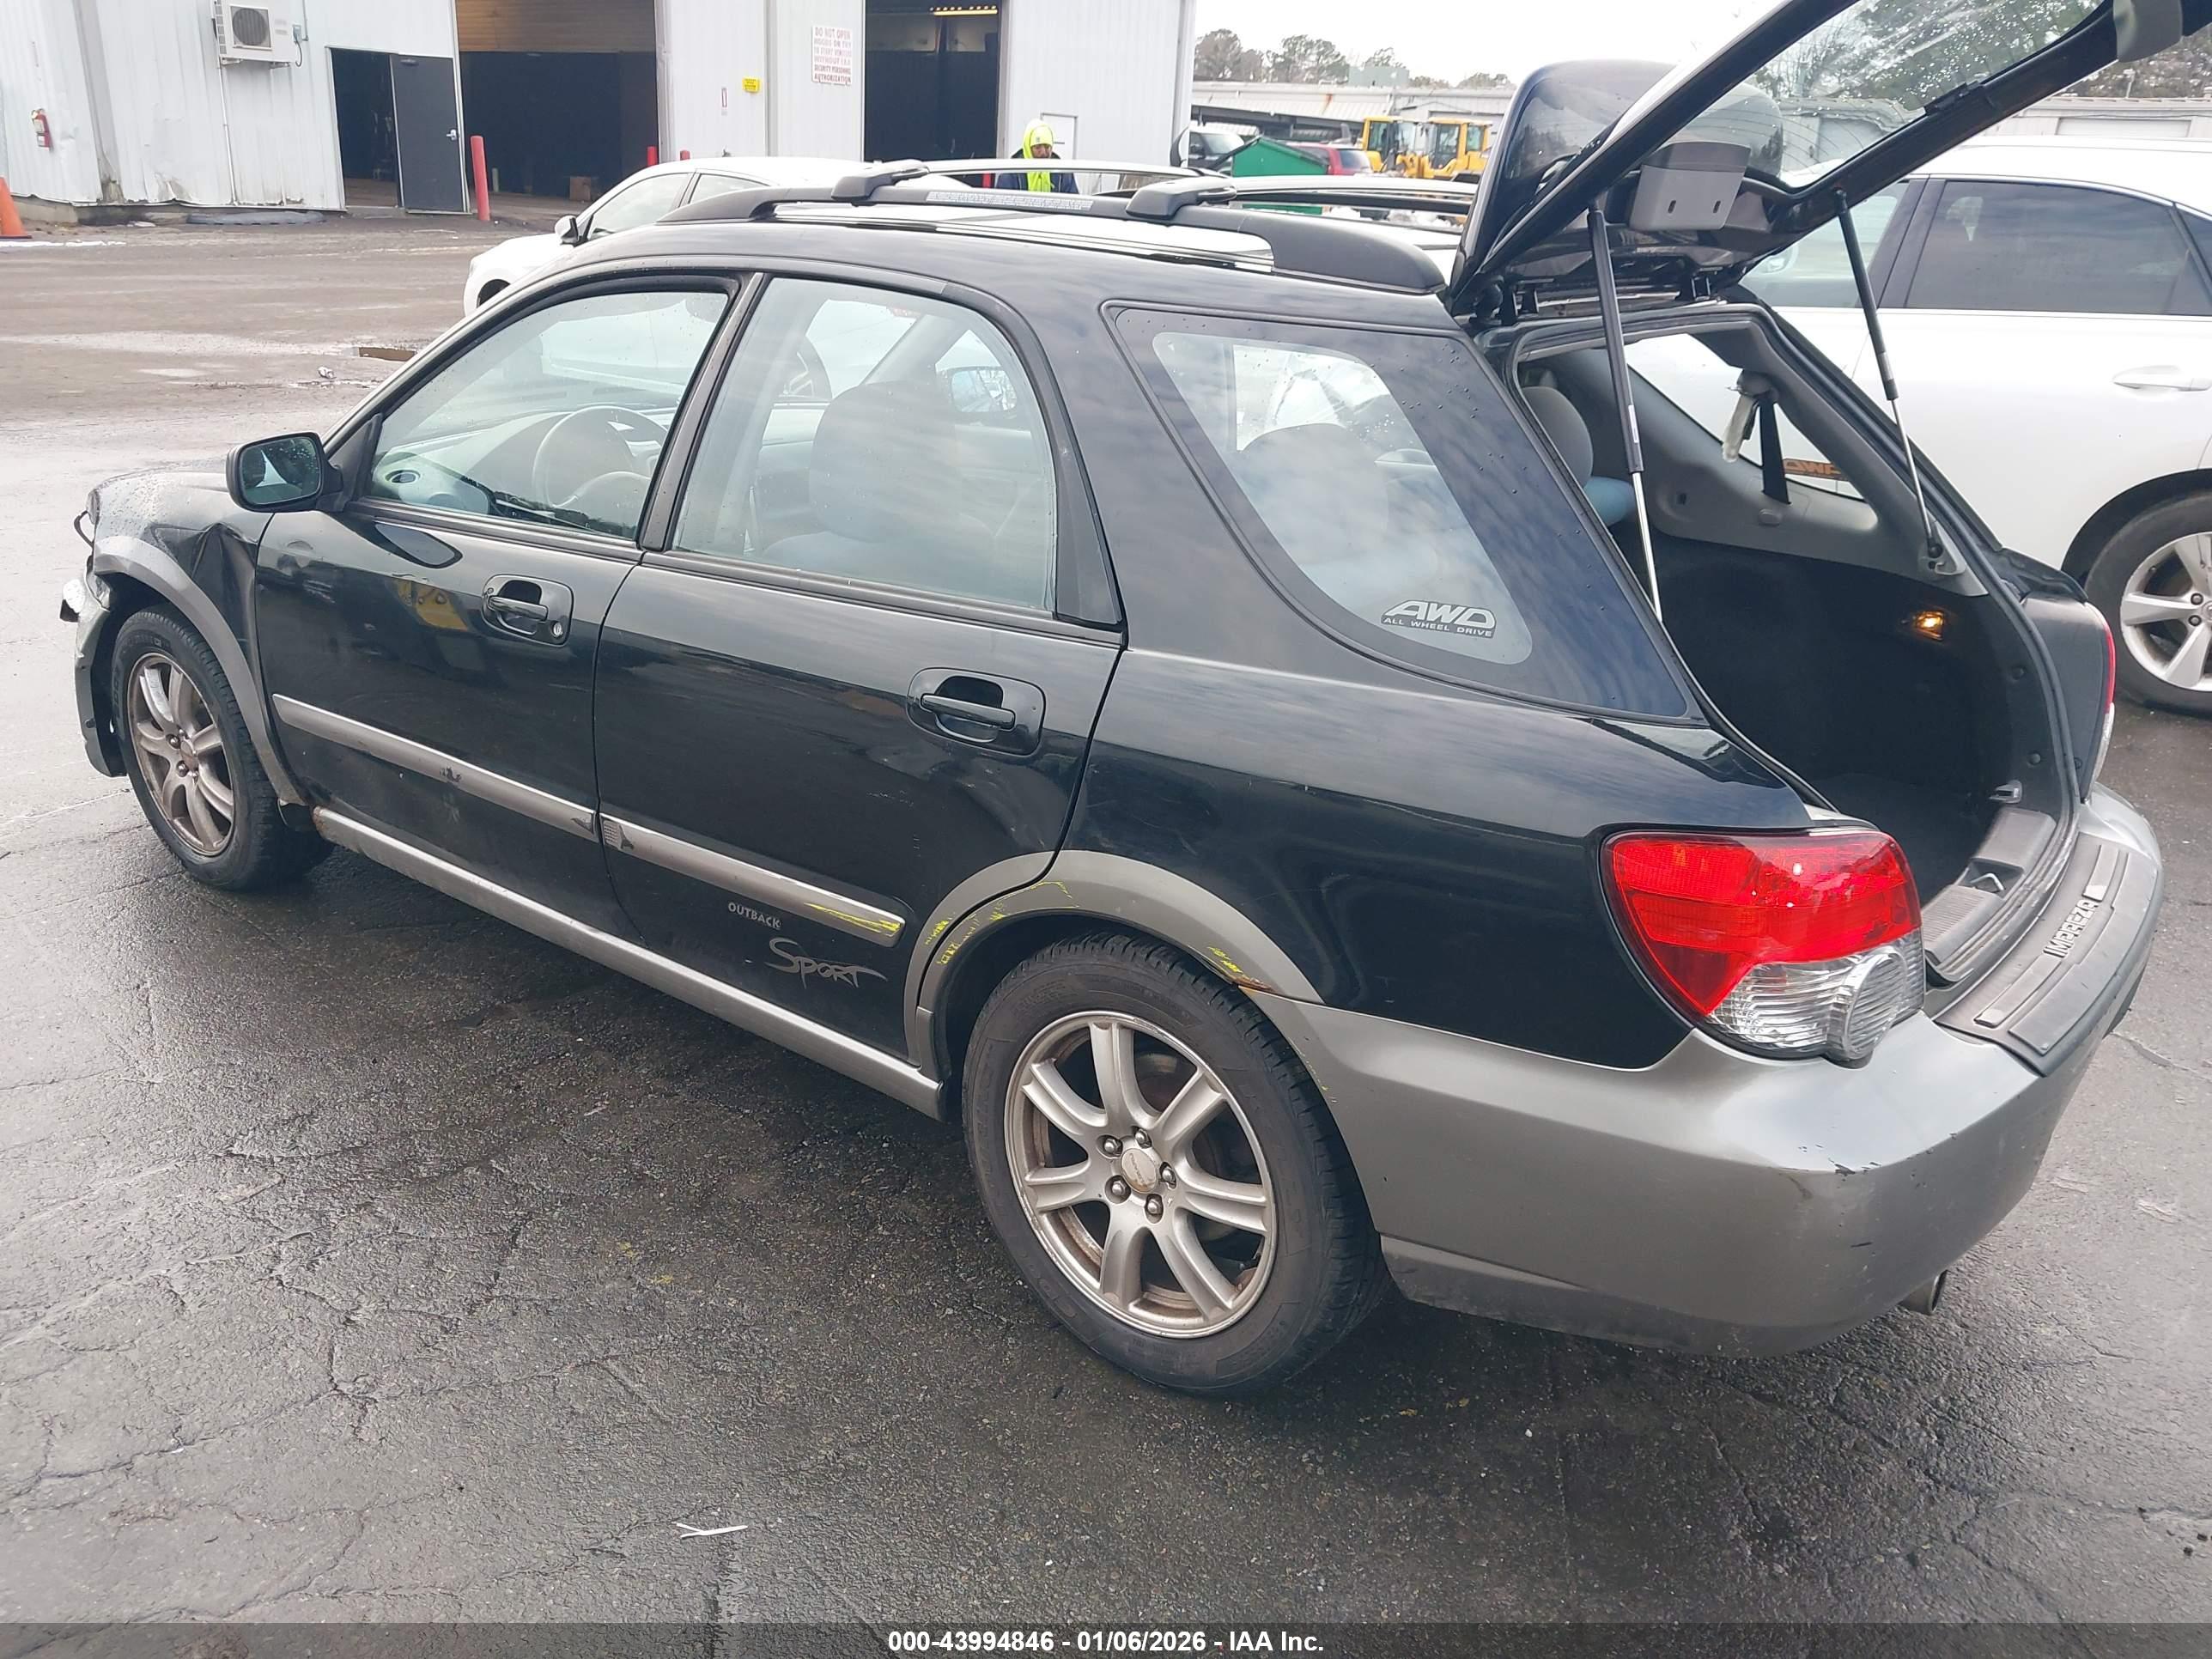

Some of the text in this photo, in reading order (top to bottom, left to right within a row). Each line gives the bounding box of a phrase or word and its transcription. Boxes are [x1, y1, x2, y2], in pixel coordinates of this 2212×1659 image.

[815, 27, 851, 40] DO NOT OPEN
[814, 73, 852, 83] AUTHORIZATION
[1384, 600, 1496, 629] AWD
[1383, 617, 1492, 637] ALL WHEEL DRIVE
[727, 902, 781, 929] OUTBACK
[2043, 899, 2099, 958] IMPREZA
